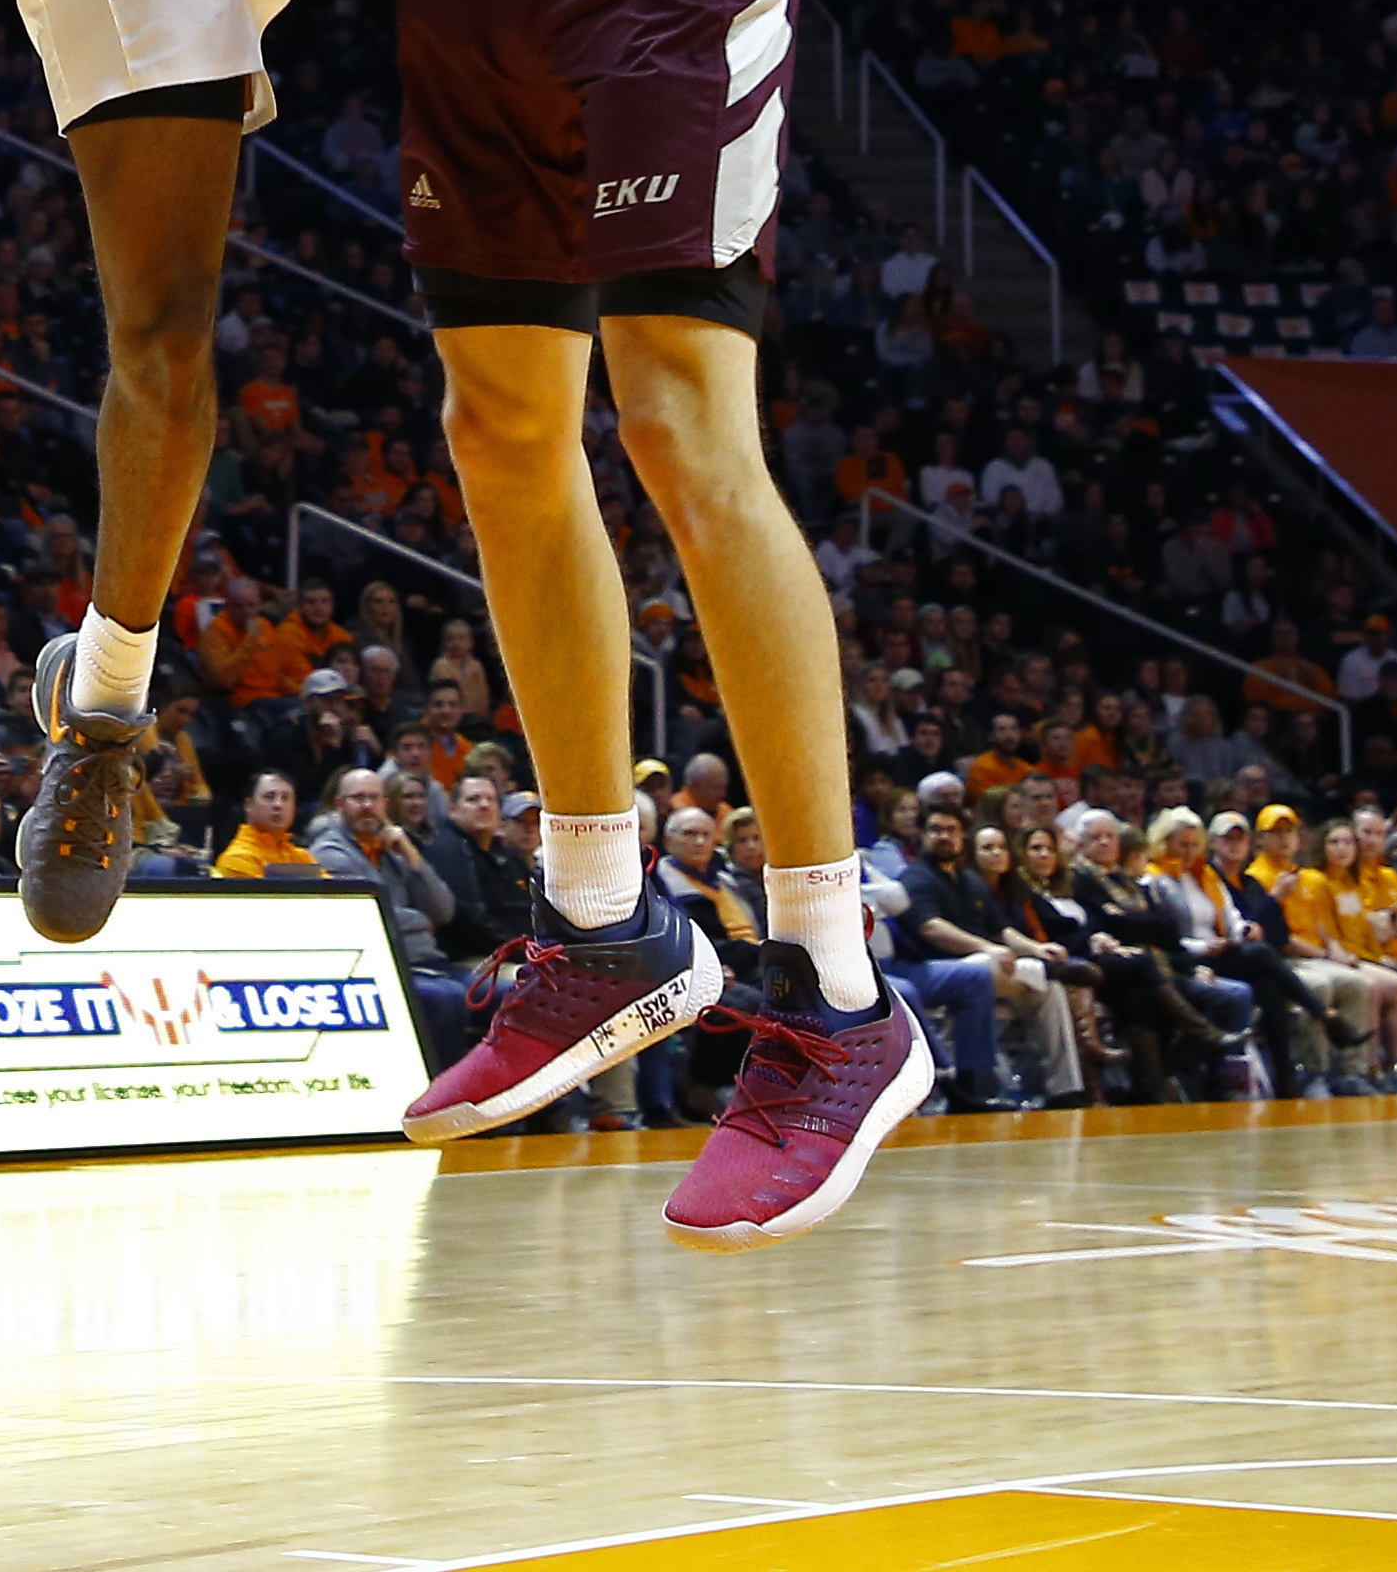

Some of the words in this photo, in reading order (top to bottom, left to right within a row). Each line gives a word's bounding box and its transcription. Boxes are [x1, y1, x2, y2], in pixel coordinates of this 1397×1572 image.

[594, 174, 680, 210] EKU
[549, 818, 633, 837] Supreme
[668, 977, 687, 996] 21
[71, 987, 115, 1032] IT
[208, 985, 247, 1029] &
[243, 984, 346, 1028] LOSE
[342, 983, 381, 1025] IT
[45, 1086, 86, 1109] your
[171, 1081, 211, 1104] your
[303, 1077, 340, 1098] your
